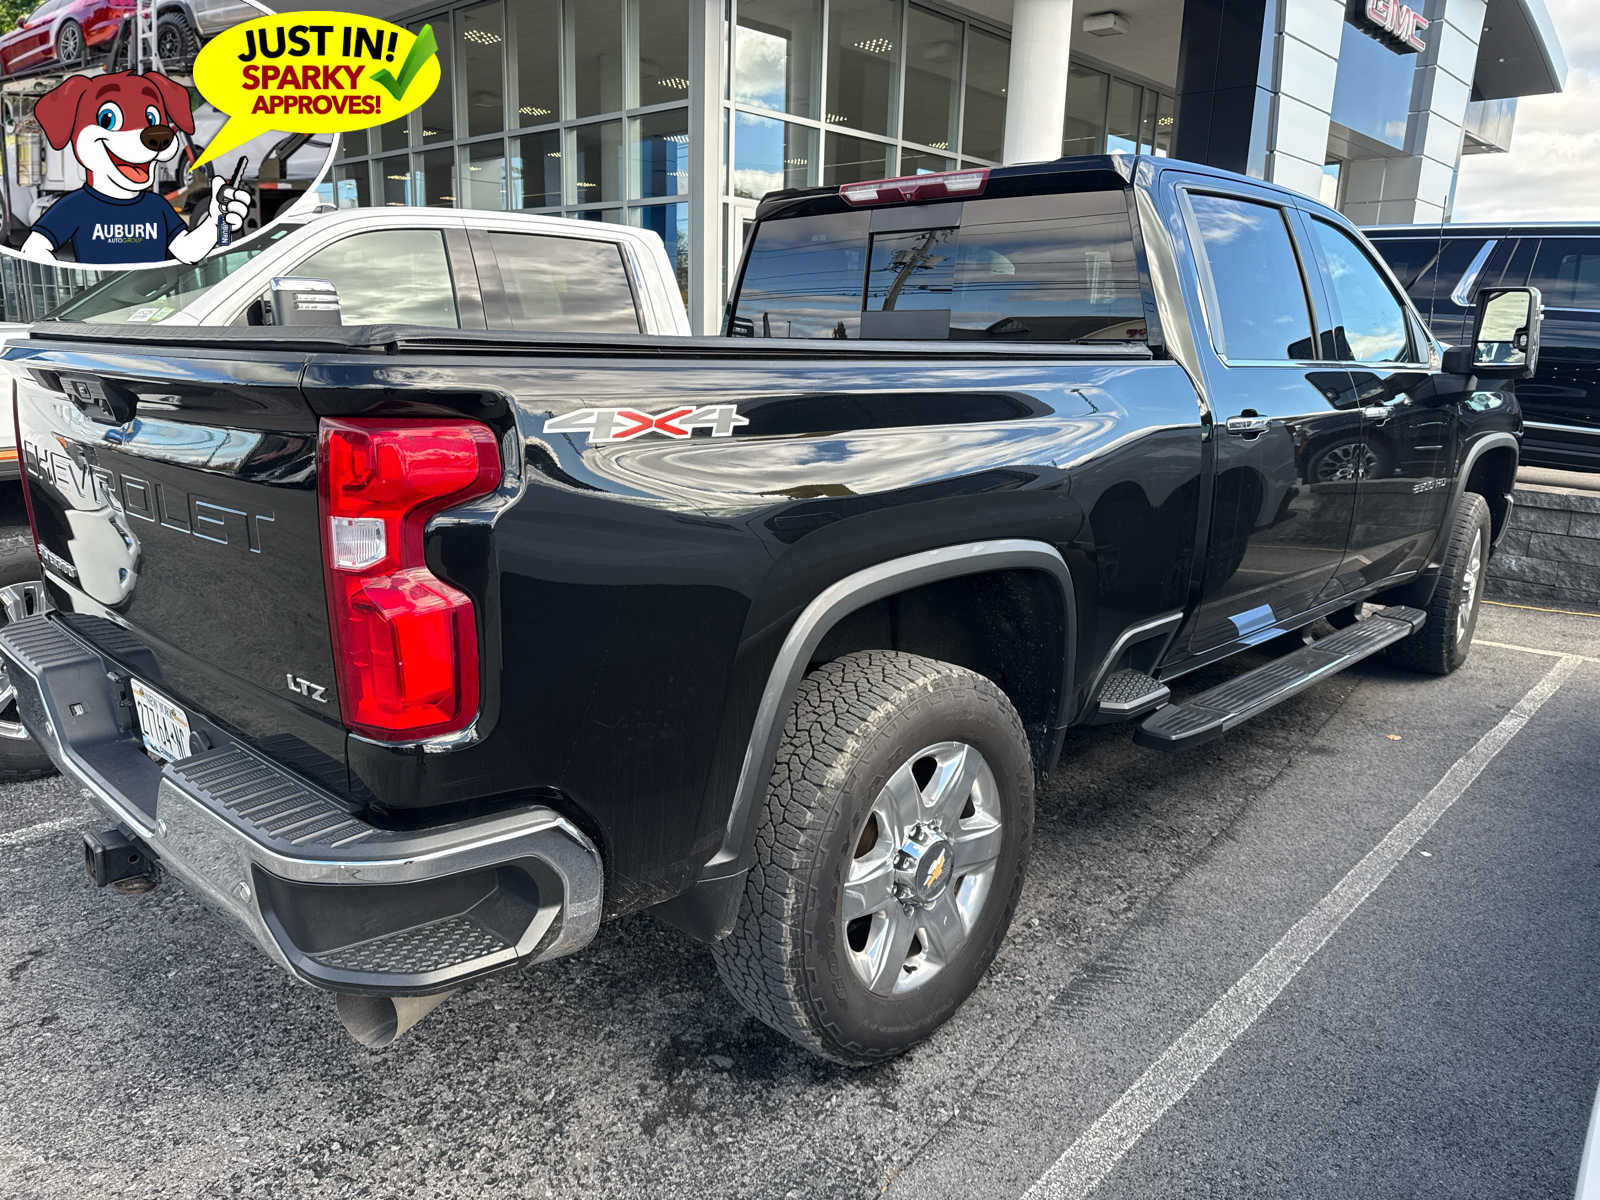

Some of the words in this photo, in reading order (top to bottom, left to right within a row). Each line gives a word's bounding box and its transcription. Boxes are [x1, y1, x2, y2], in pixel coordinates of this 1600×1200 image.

[1365, 0, 1429, 53] GMC
[23, 439, 275, 554] CHEVROLET
[286, 673, 328, 704] LTZ
